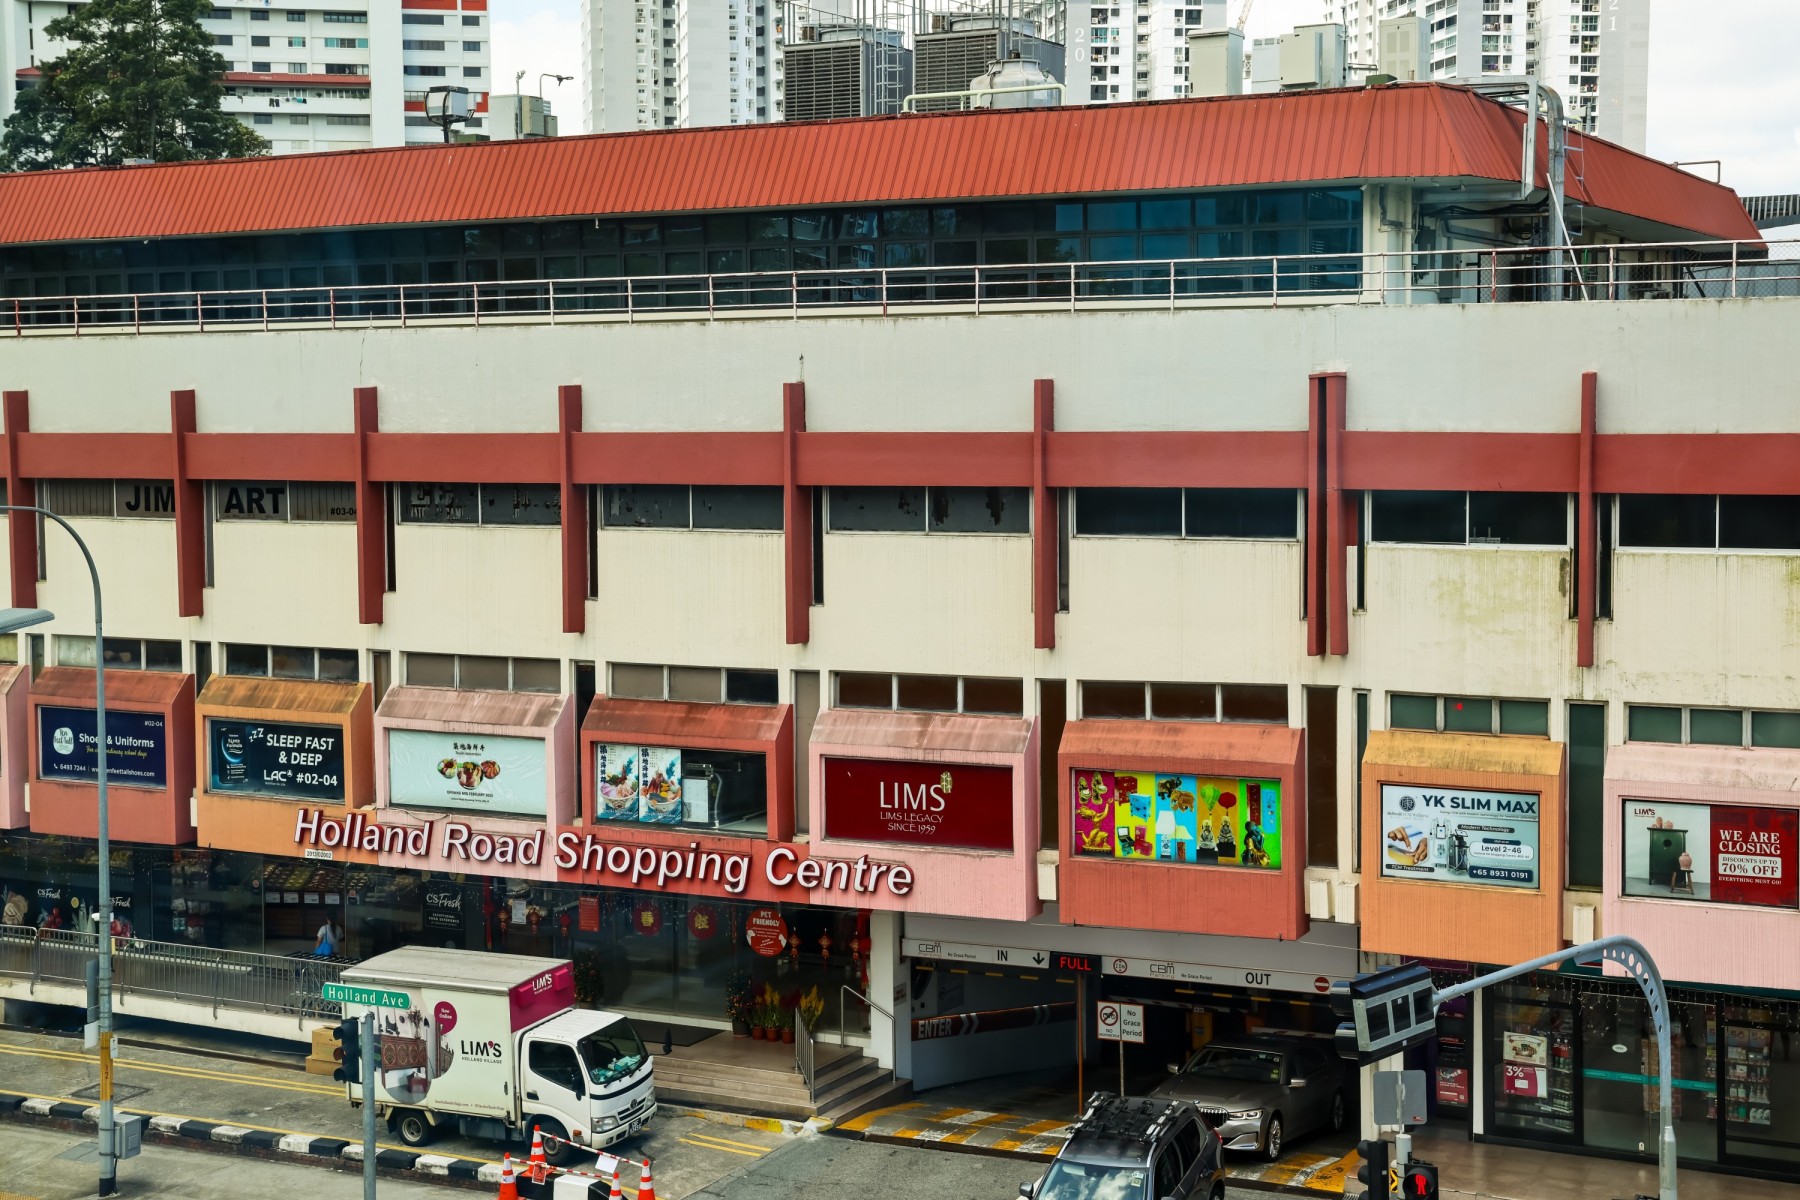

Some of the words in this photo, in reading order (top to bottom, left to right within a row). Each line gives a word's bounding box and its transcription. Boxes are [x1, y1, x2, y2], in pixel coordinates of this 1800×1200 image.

[125, 485, 175, 512] JIM
[224, 487, 285, 514] ART
[79, 734, 98, 744] Shoe
[107, 736, 113, 744] &
[115, 736, 154, 748] Uniforms
[266, 734, 302, 748] SLEEP
[305, 737, 334, 750] FAST
[279, 751, 287, 764] &
[291, 752, 322, 766] DEEP
[264, 770, 286, 782] LAC
[296, 773, 338, 786] #02-04
[880, 782, 945, 811] LIMS
[1422, 795, 1445, 808] YK
[1450, 797, 1491, 811] SLIM
[1497, 800, 1536, 814] MAX
[880, 811, 902, 821] LIMS
[904, 813, 943, 823] LEGACY
[1634, 808, 1655, 816] LIM'S
[888, 822, 916, 832] SINCE
[918, 825, 936, 834] 1959
[1719, 830, 1742, 842] WE
[1749, 832, 1780, 844] ARE
[294, 808, 433, 856] Holland
[442, 822, 545, 866] Road
[554, 832, 750, 894] Shopping
[765, 846, 914, 895] Centre
[1719, 841, 1781, 855] CLOSING
[1511, 871, 1528, 879] 0191
[1722, 863, 1748, 874] 70%
[1752, 865, 1778, 876] OFF
[439, 893, 462, 911] Fresh
[753, 918, 780, 927] FRIENDLY
[997, 950, 1008, 961] IN
[1059, 956, 1092, 970] FULL
[532, 974, 552, 991] LIM'S
[1245, 972, 1271, 986] OUT
[328, 986, 376, 1004] Holland
[382, 993, 404, 1007] Ave
[918, 1018, 952, 1039] ENTER
[461, 1040, 502, 1057] LIM'S
[1506, 1066, 1524, 1078] 3%
